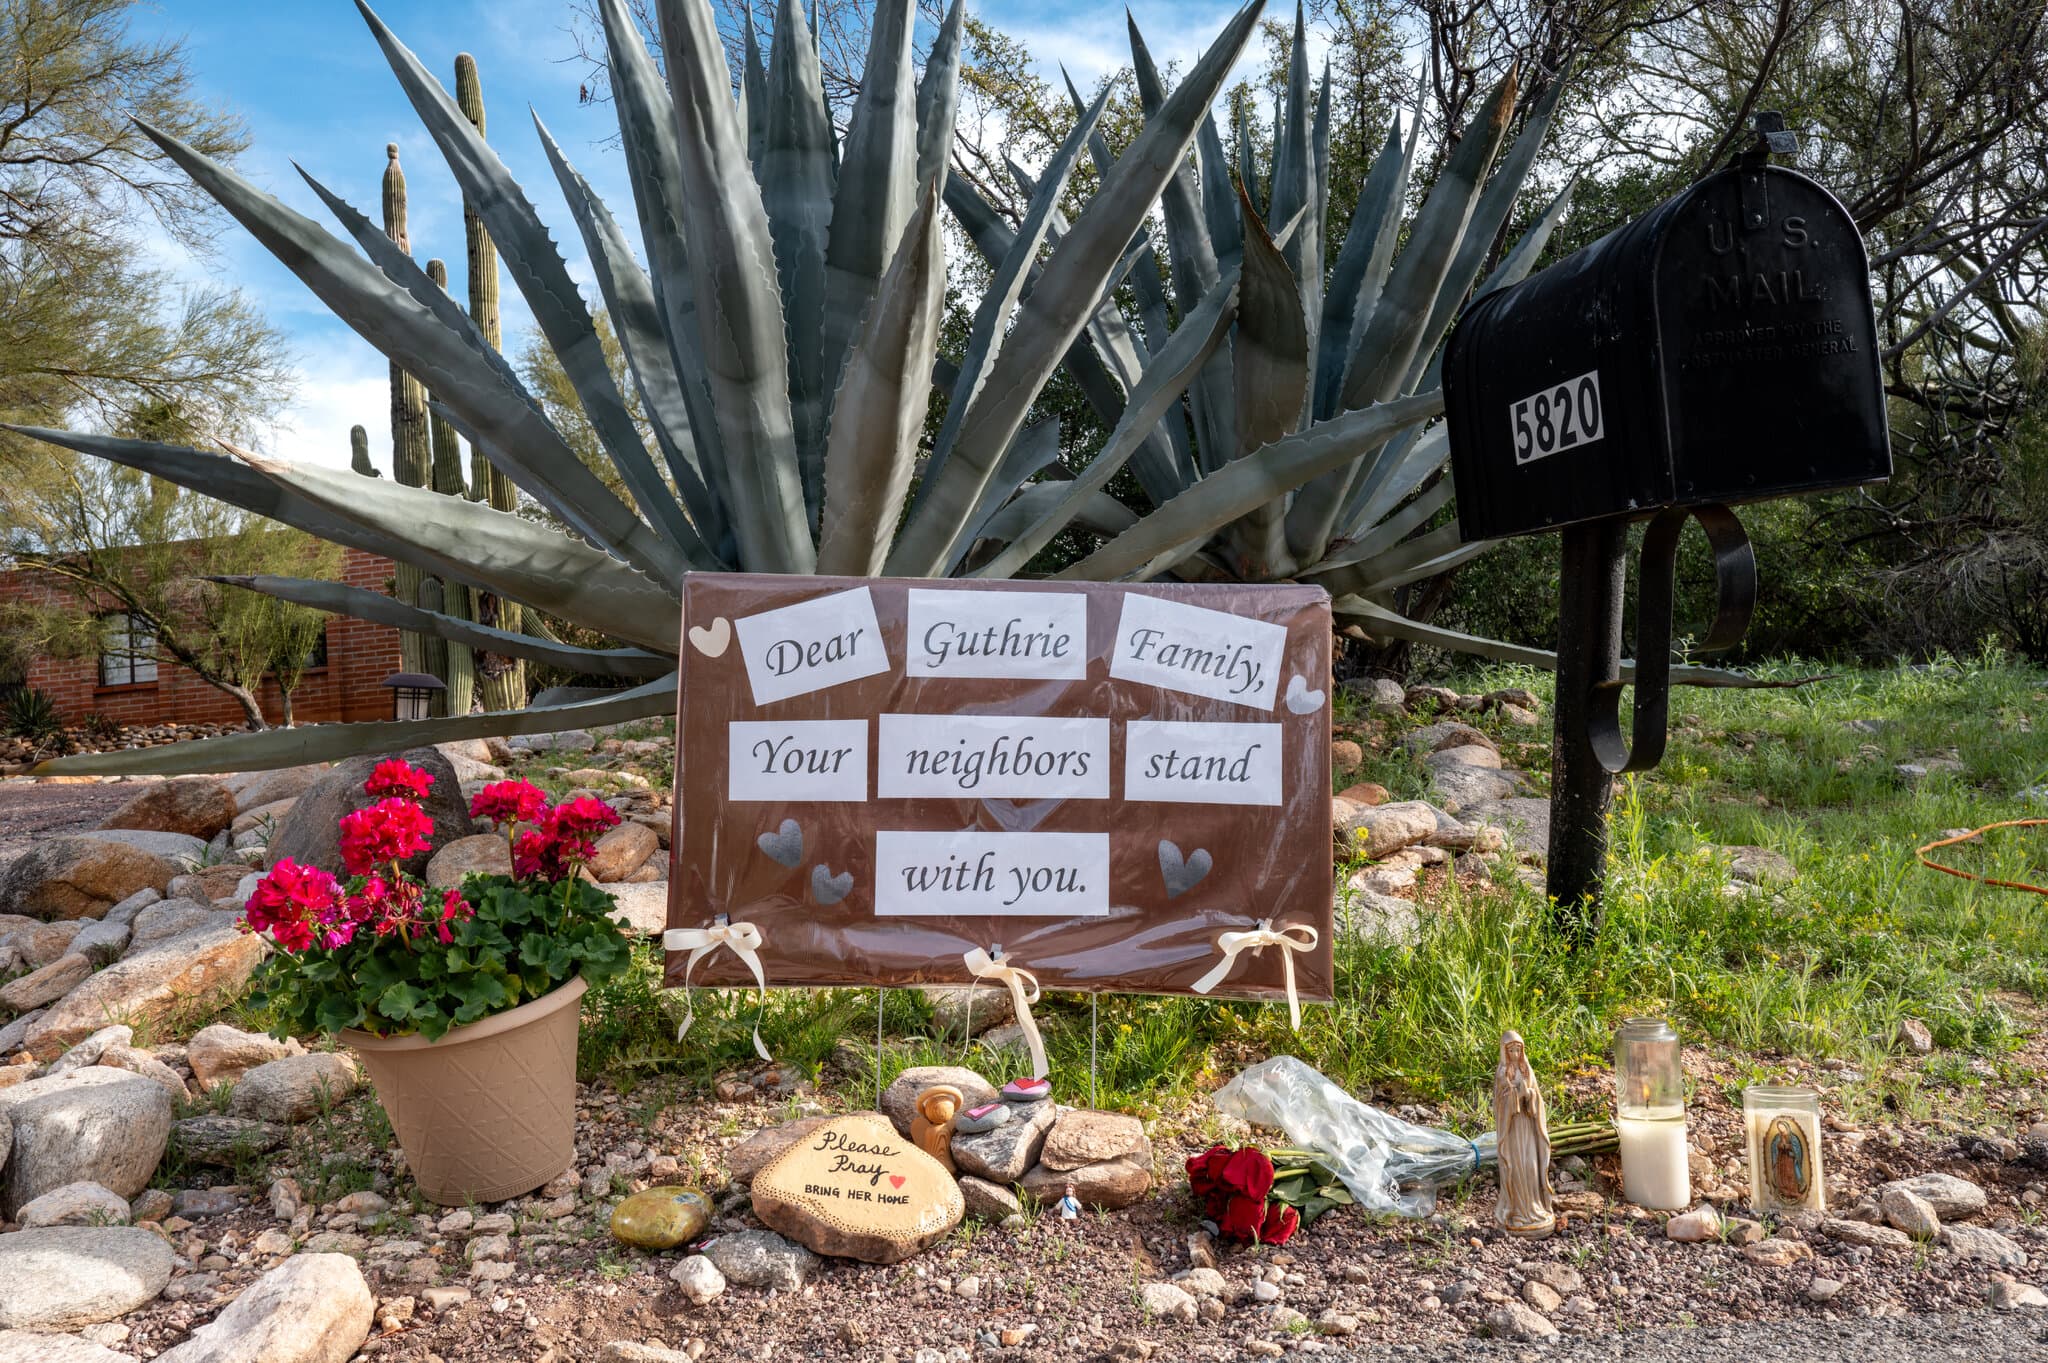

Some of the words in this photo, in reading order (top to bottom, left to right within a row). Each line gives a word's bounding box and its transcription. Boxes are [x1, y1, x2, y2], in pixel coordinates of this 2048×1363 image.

[1783, 216, 1819, 248] S.
[1704, 270, 1821, 312] MAIL
[1815, 319, 1843, 337] THE
[1516, 377, 1599, 459] 5820
[765, 628, 864, 677] Dear
[924, 619, 1070, 668] Guthrie
[1129, 628, 1264, 694] Family,
[752, 735, 853, 774] Your
[906, 736, 1091, 788] neighbors
[1144, 743, 1262, 783] stand
[901, 851, 995, 892] with
[1002, 867, 1086, 906] you.
[813, 1130, 901, 1156] Please
[828, 1154, 890, 1187] Pray
[804, 1184, 840, 1198] BRING
[847, 1189, 872, 1202] HER
[877, 1194, 910, 1206] HOME
